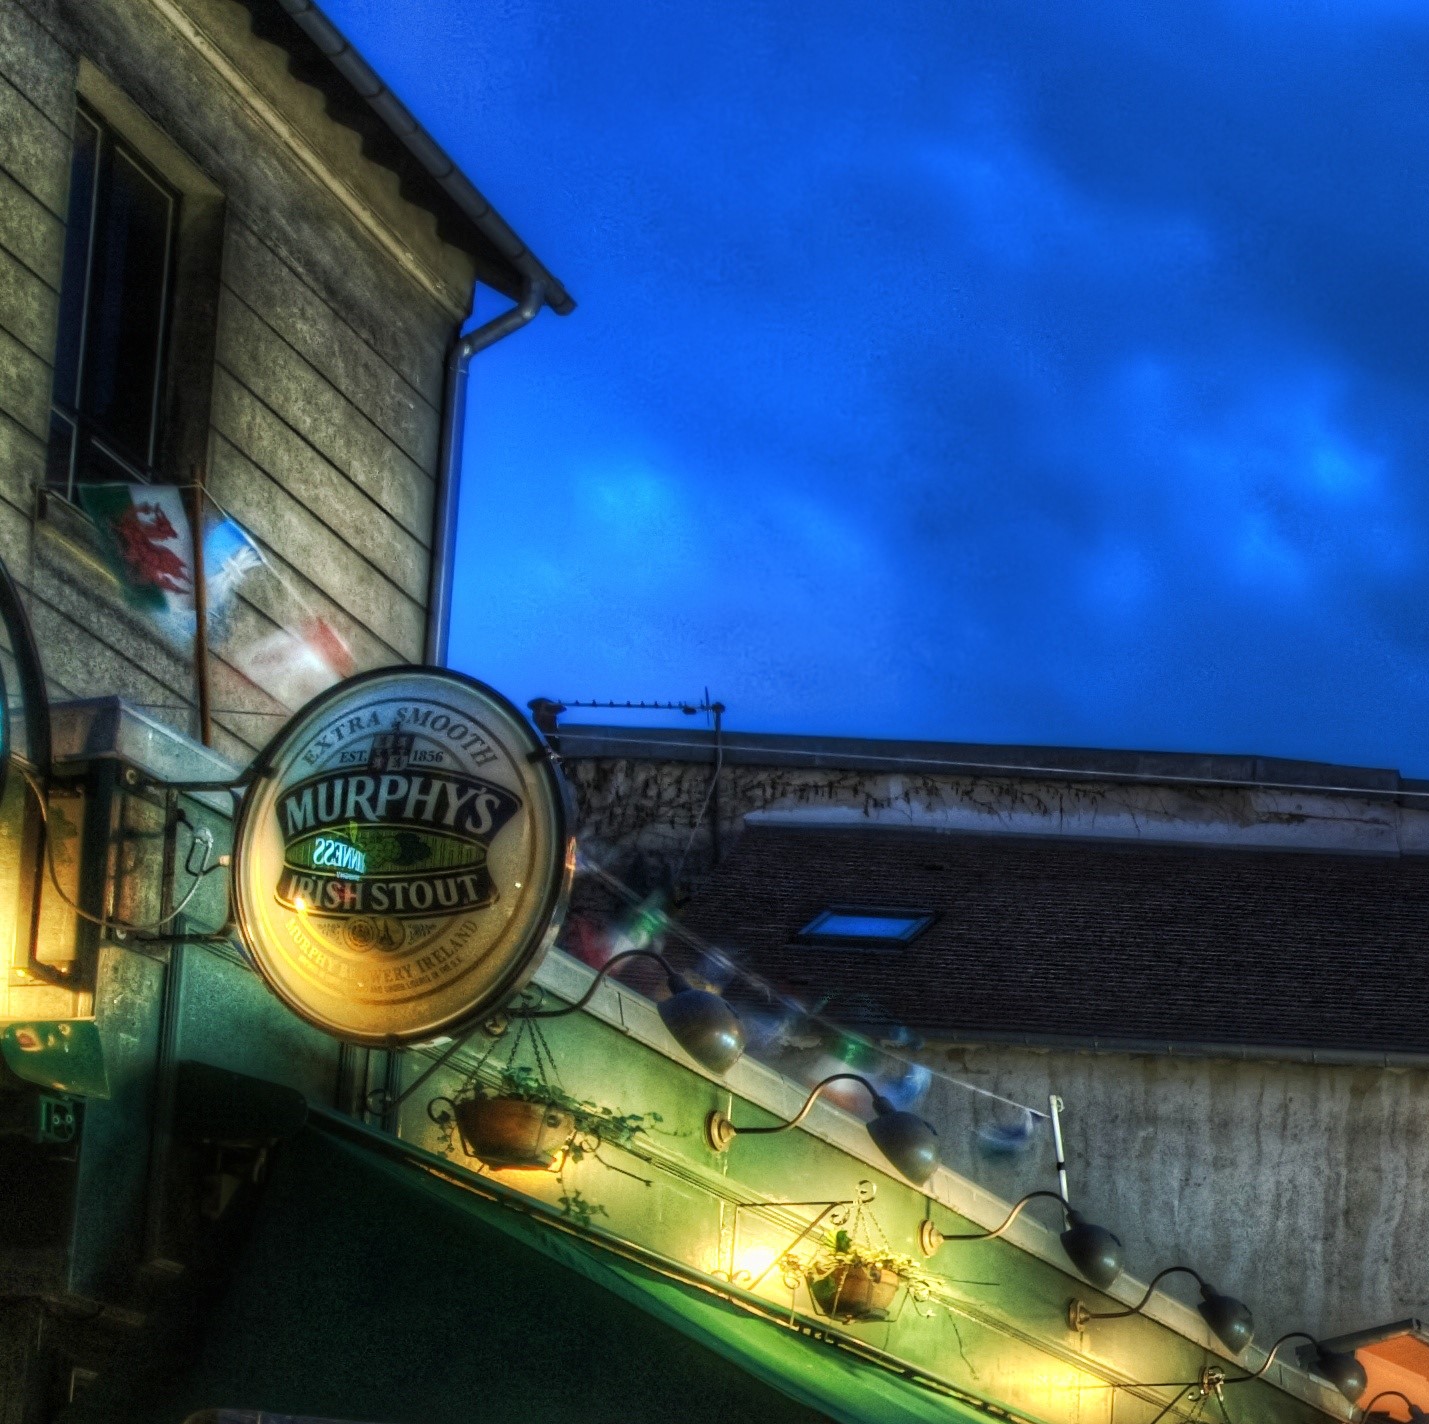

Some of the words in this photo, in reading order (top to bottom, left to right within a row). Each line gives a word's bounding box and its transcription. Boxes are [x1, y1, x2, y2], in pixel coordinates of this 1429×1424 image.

[303, 709, 381, 765] EXTRA
[396, 707, 498, 767] SMOOTH
[339, 751, 366, 763] EST.
[413, 750, 443, 763] 1856
[285, 775, 501, 836] MURPHY'S
[288, 874, 362, 911] IRISH
[372, 874, 481, 911] STOUT
[418, 920, 478, 973] IRELAND
